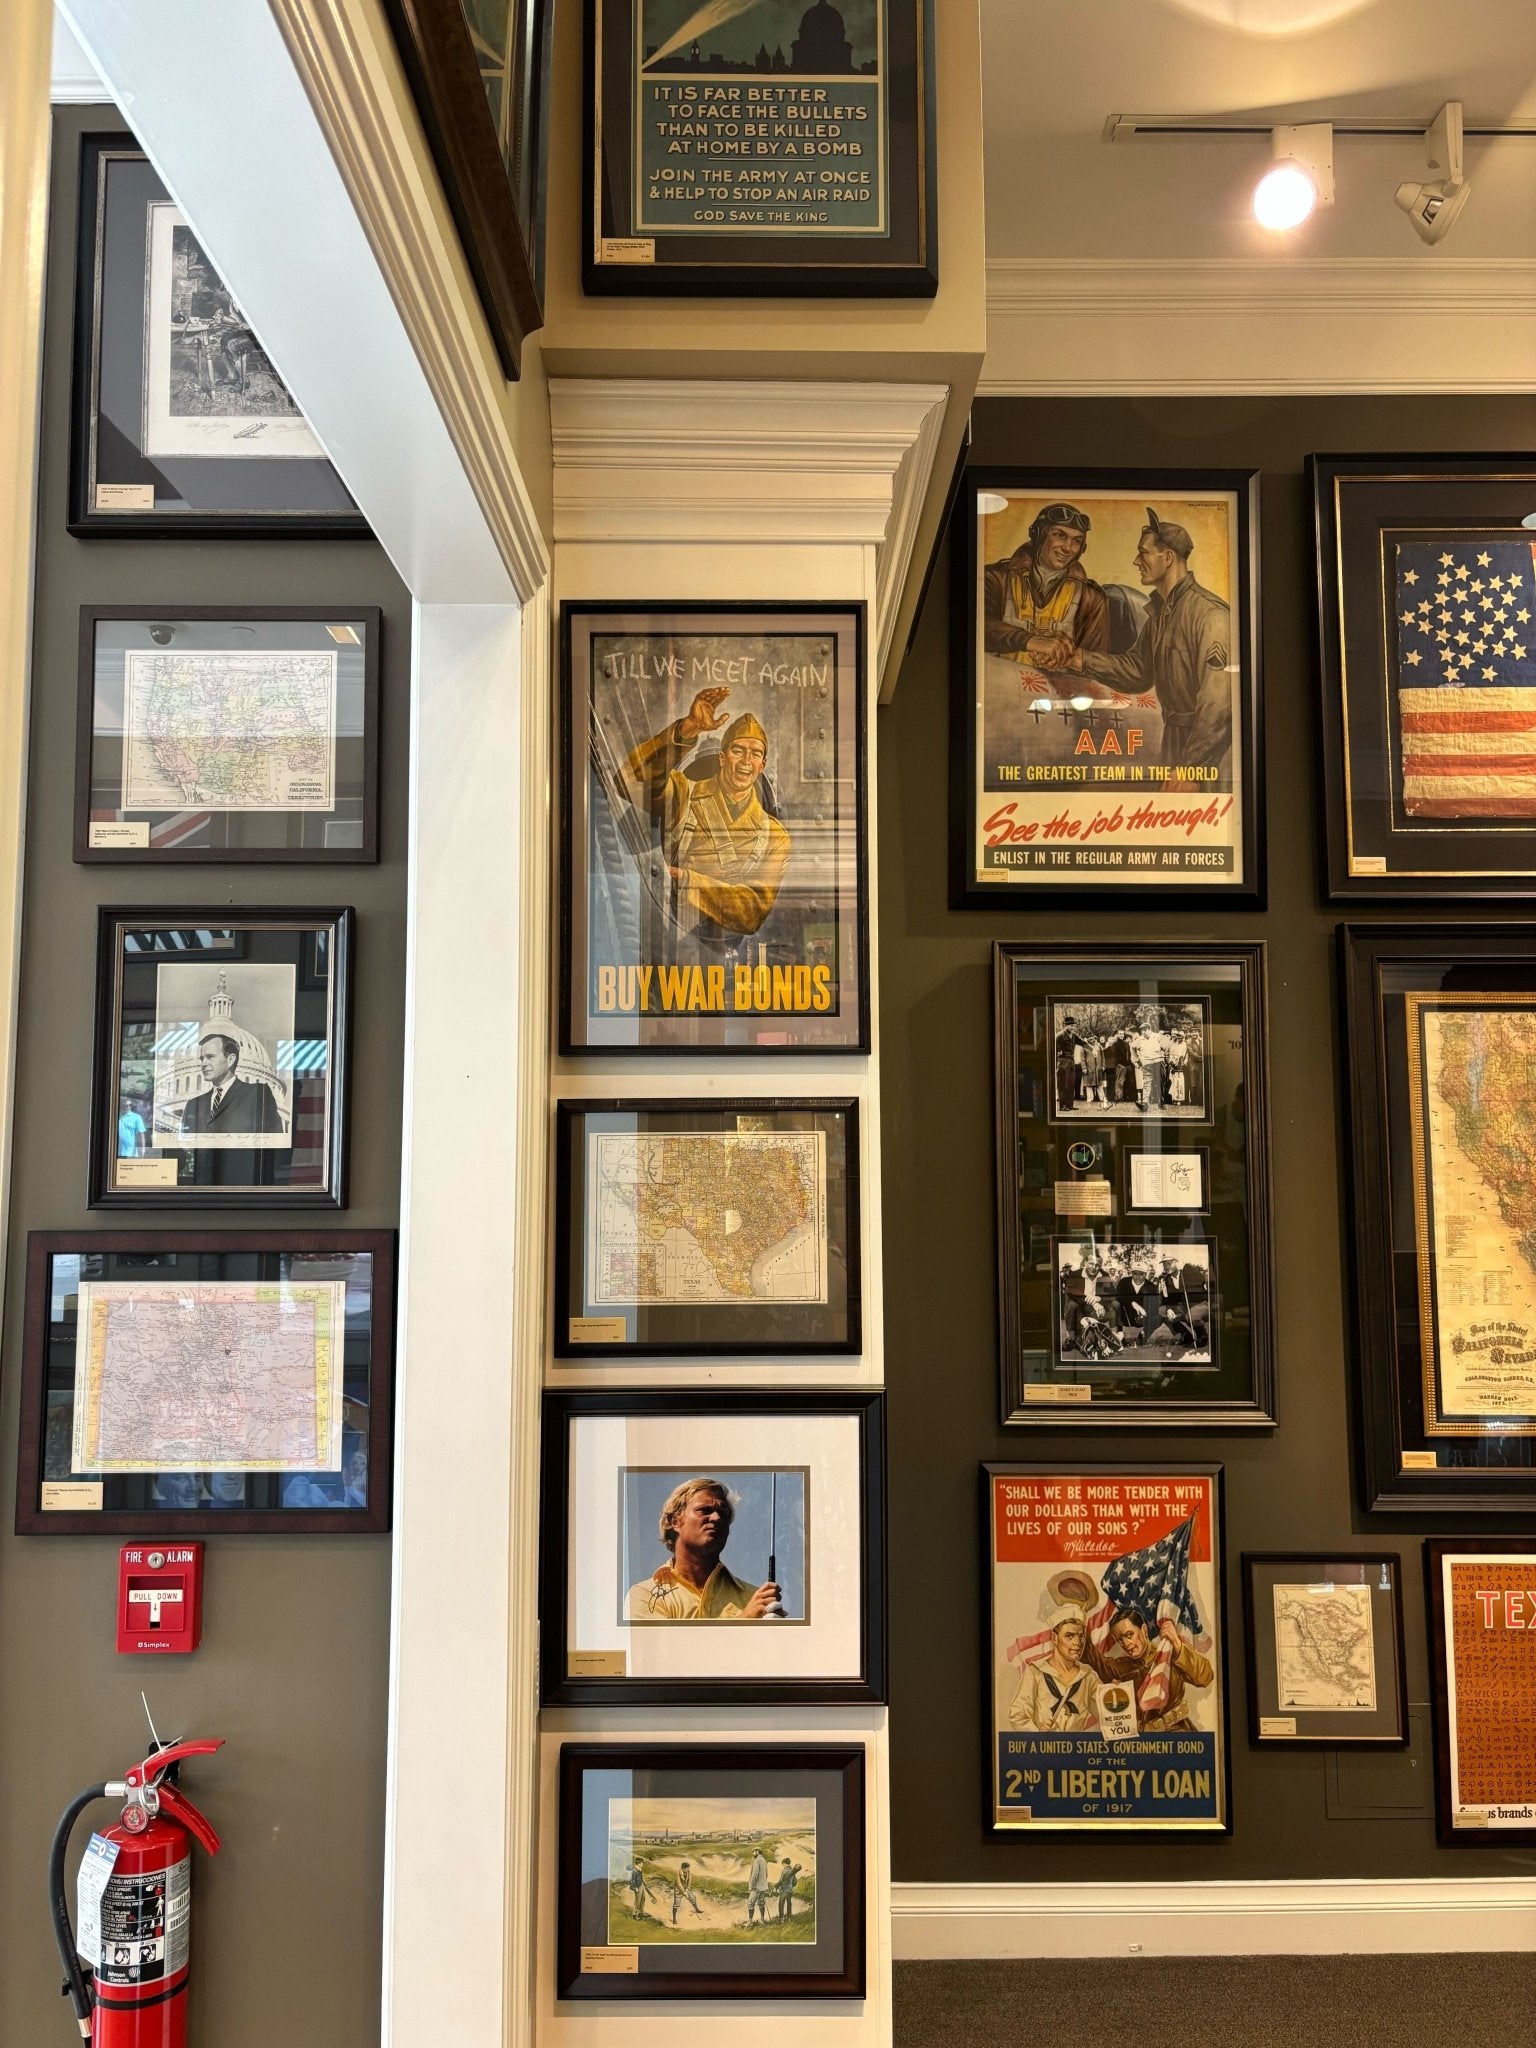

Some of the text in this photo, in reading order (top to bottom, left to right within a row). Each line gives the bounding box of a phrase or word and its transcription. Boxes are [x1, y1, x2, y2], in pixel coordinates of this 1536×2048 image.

[654, 86, 828, 102] IT IS FAR BETTER
[668, 104, 868, 120] TO FACE THE BULLETS
[656, 122, 841, 138] THAN TO BE KILLED
[667, 140, 862, 155] AT HOME BY A BOMB
[650, 168, 870, 184] JOIN THE ARMY AT ONCE
[650, 186, 870, 201] & HELP TO STOP AN AIR RAID
[694, 210, 828, 222] GOD SAVE THE KING
[604, 652, 828, 688] TILL WE MEET AGAIN
[1074, 729, 1143, 755] AAF
[998, 766, 1218, 780] THE GREATEST TEAM IN THE WORLD
[983, 796, 1233, 848] See the job through!
[994, 851, 1224, 866] ENLIST IN THE REGULAR ARMY AIR FORCES
[599, 964, 831, 1011] BUY WAR BONDS
[1491, 1348, 1536, 1364] NEVAD
[1044, 1486, 1061, 1499] WE
[1067, 1486, 1082, 1499] BE
[1087, 1486, 1119, 1499] MORE
[1124, 1486, 1169, 1499] TENDER
[1174, 1486, 1203, 1499] WITH
[1006, 1504, 1187, 1517] OUR DOLLARS THAN WITH THE
[1007, 1522, 1040, 1535] LIVES
[1047, 1522, 1062, 1535] OF
[1067, 1522, 1092, 1535] OUR
[126, 1551, 193, 1562] FIRE ALARM
[1110, 1726, 1130, 1735] YOU
[1008, 1741, 1204, 1754] BUY A UNITED STATES GOVERNMENT BOND
[1005, 1770, 1210, 1798] 2ND LIBERTY LOAN
[1083, 1804, 1132, 1813] OF 1917
[1497, 1806, 1532, 1818] brands
